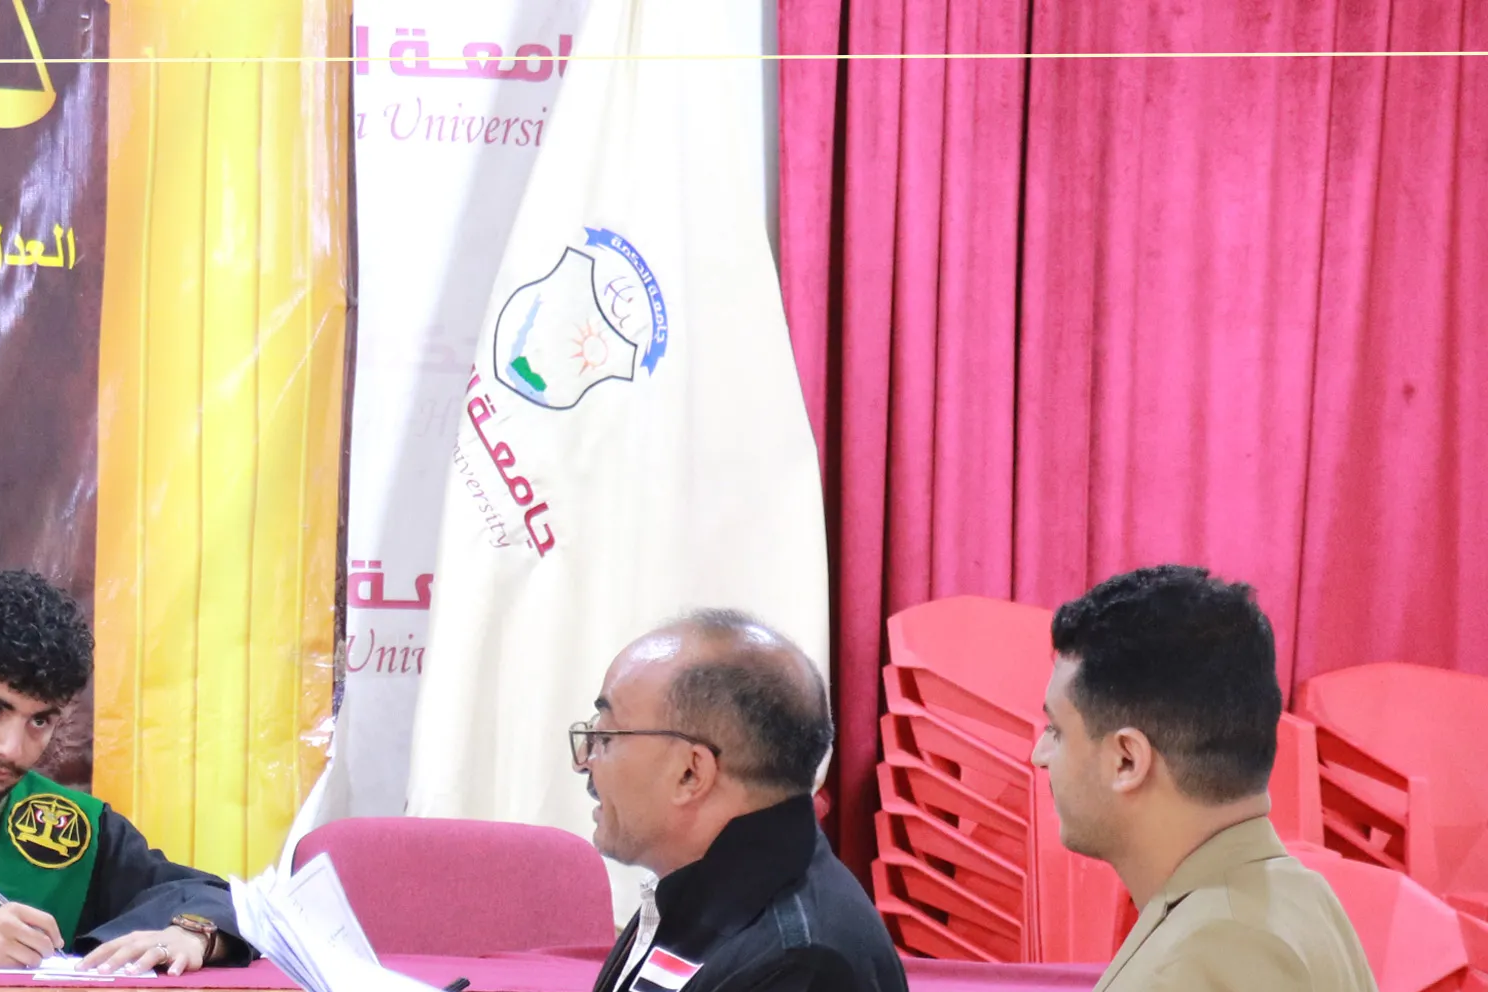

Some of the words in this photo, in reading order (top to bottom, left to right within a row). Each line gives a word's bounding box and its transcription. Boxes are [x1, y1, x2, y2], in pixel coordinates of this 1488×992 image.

[389, 27, 574, 83] امعة
[383, 96, 549, 148] Universi
[453, 434, 511, 549] niversity
[467, 393, 556, 558] جامعة
